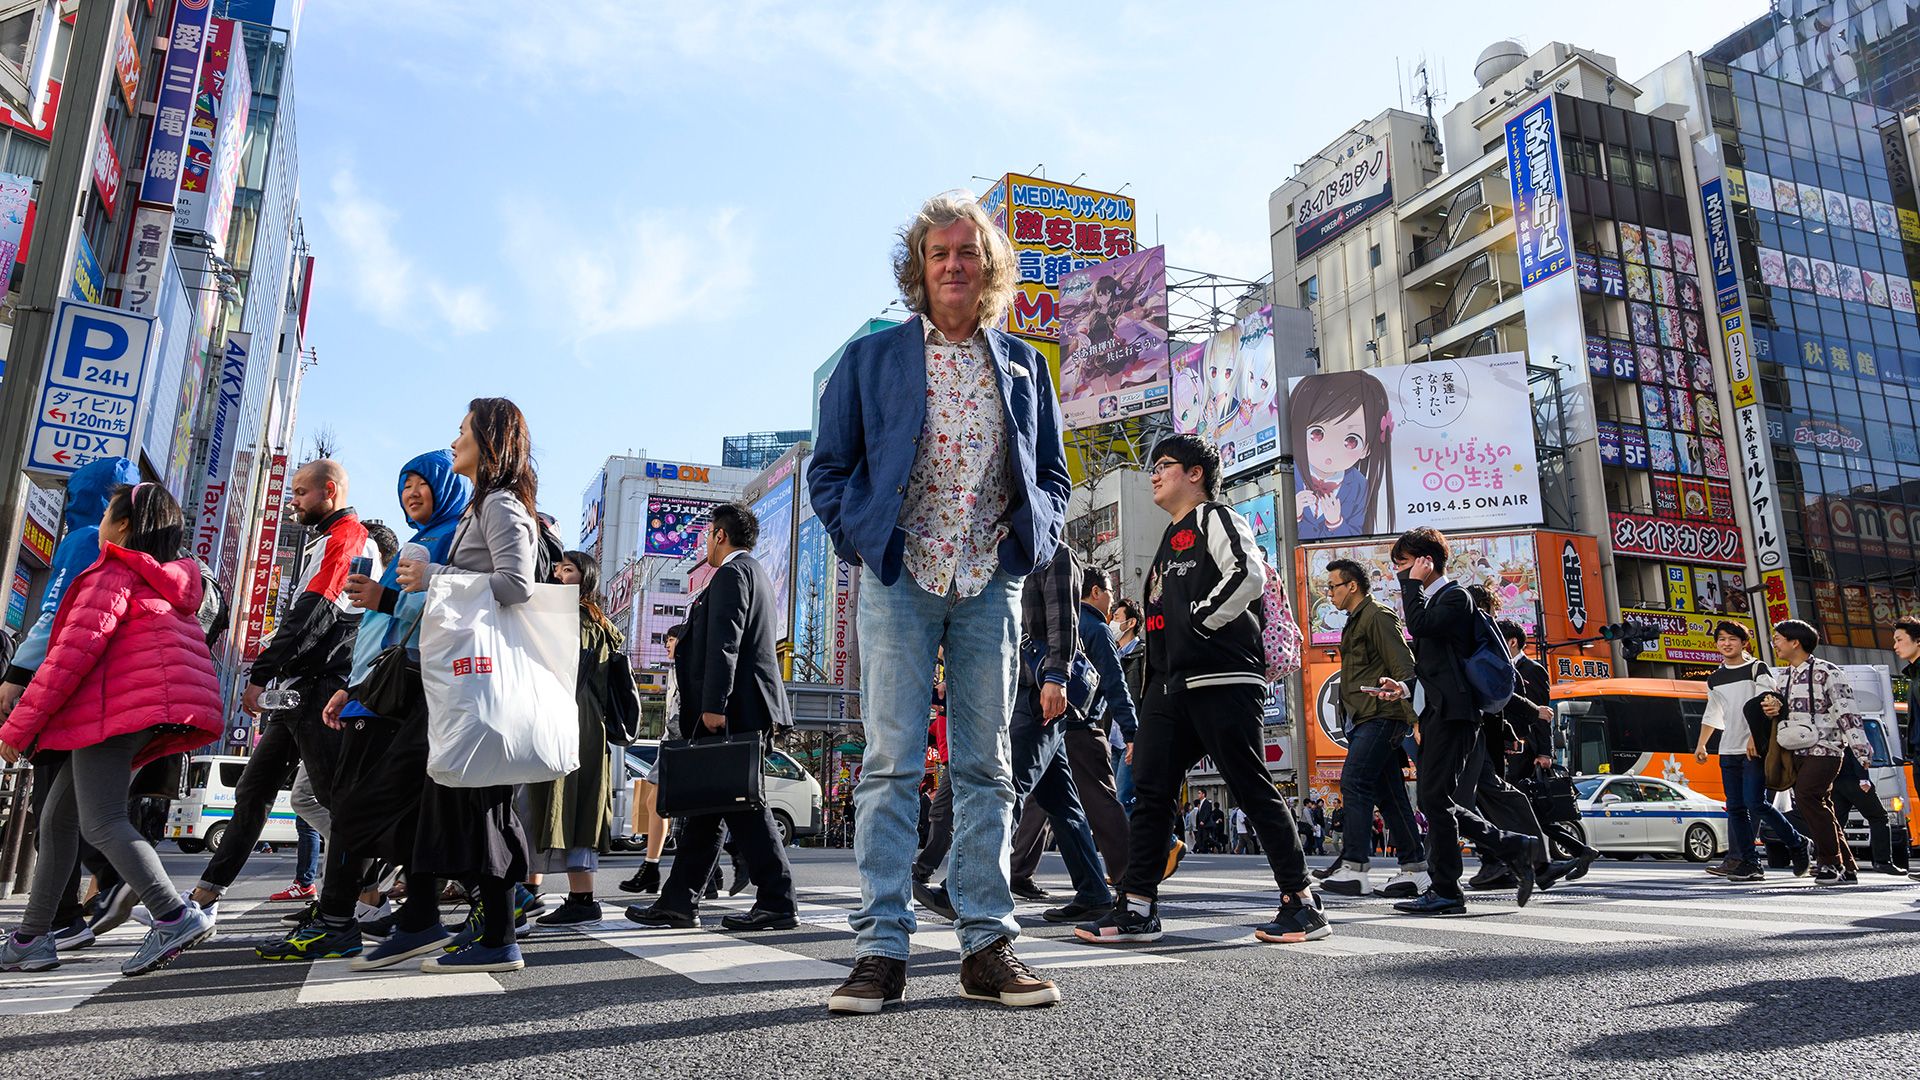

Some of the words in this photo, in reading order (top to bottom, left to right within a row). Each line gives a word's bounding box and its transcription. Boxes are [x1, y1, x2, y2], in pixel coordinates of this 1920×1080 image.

[150, 23, 202, 181] 愛三電機
[1300, 150, 1383, 224] メイドカジノ
[1013, 184, 1133, 220] MEDIAリサイクル
[1014, 210, 1132, 258] 激安販売
[1602, 276, 1624, 296] 7F
[1727, 318, 1740, 330] 3F
[62, 315, 129, 379] P
[84, 366, 130, 388] 24H
[221, 338, 246, 409] AKKY
[1613, 357, 1635, 377] 6F
[1428, 373, 1442, 417] なりたい
[1442, 371, 1456, 405] 友達に
[52, 391, 127, 416] ダイビル
[69, 410, 127, 432] 120m先
[208, 389, 230, 479] INTERNATIONAL
[53, 430, 110, 455] UDX
[1414, 437, 1512, 471] ひとりぼっちの
[1624, 444, 1646, 465] 5F
[1407, 498, 1471, 514] 2019.4.5
[1475, 496, 1499, 509] ON
[1502, 494, 1529, 507] AIR
[1656, 499, 1677, 510] Stars
[1615, 518, 1738, 559] メイドカジノ
[1669, 583, 1687, 595] 入口
[1670, 569, 1683, 580] 3F
[836, 590, 849, 649] Tax-free
[834, 649, 847, 685] Shop
[1558, 658, 1610, 679] 質&買取
